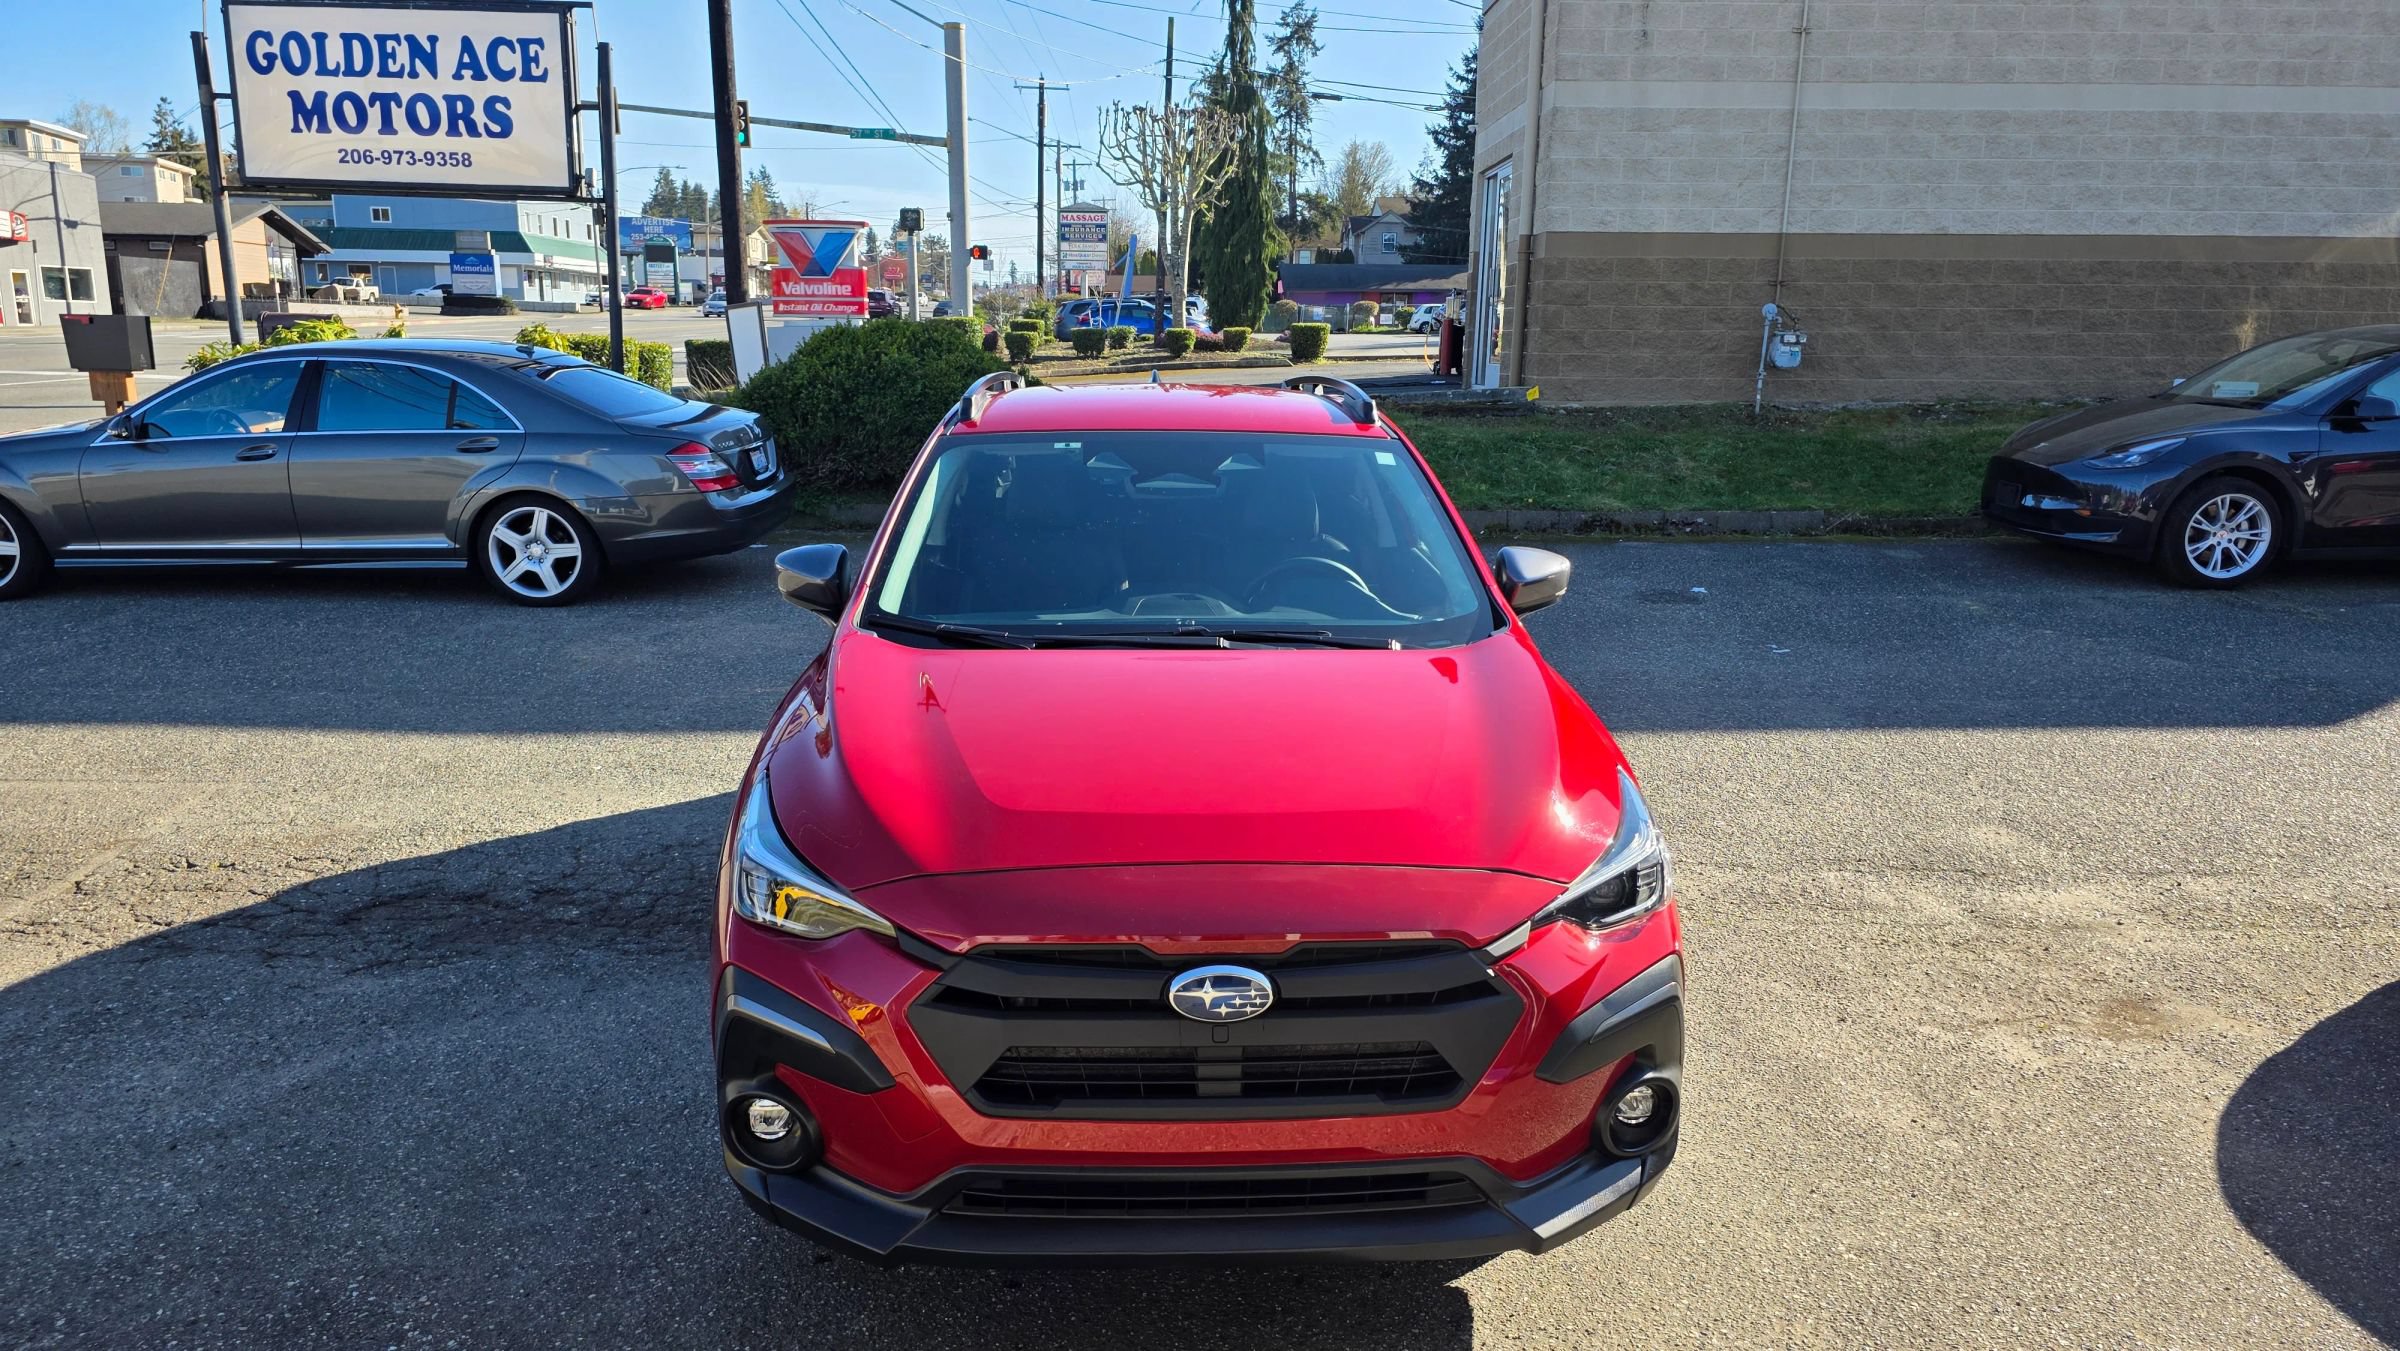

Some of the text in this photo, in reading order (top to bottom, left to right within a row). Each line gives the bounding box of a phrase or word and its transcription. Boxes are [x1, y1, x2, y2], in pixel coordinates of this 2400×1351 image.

[245, 29, 549, 83] GOLDEN ACE
[287, 89, 514, 139] MOTORS
[874, 129, 884, 138] ST
[337, 148, 473, 167] 206-973-9358
[631, 218, 675, 226] ADVERTISE
[1061, 214, 1106, 222] MASSAGE
[453, 264, 493, 272] Memorials
[781, 281, 852, 296] Valvoline
[778, 303, 859, 313] Instant Oil Change
